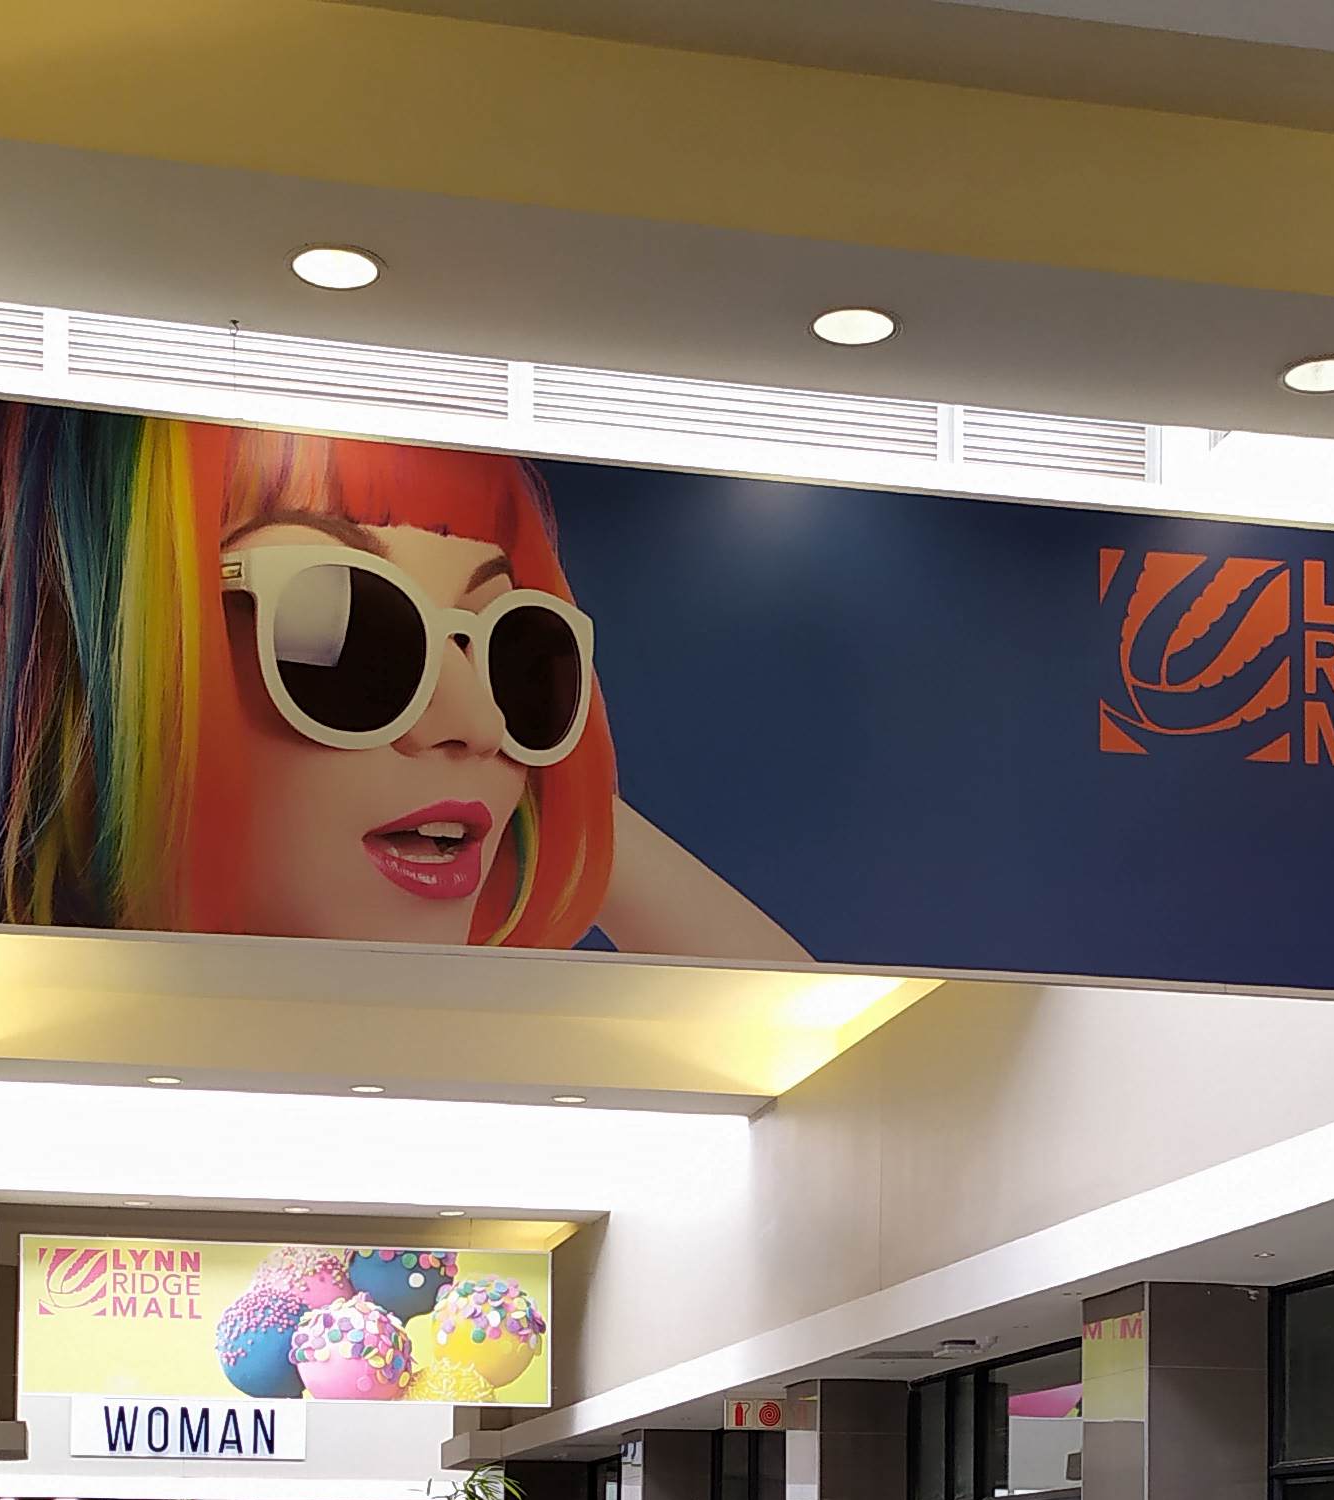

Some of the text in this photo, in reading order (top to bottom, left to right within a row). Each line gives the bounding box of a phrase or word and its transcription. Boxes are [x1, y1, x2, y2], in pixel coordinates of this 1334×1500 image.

[112, 1248, 201, 1273] LYNN
[112, 1273, 201, 1296] RIDGE
[112, 1296, 203, 1320] MALL
[104, 1405, 276, 1455] WOMAN
